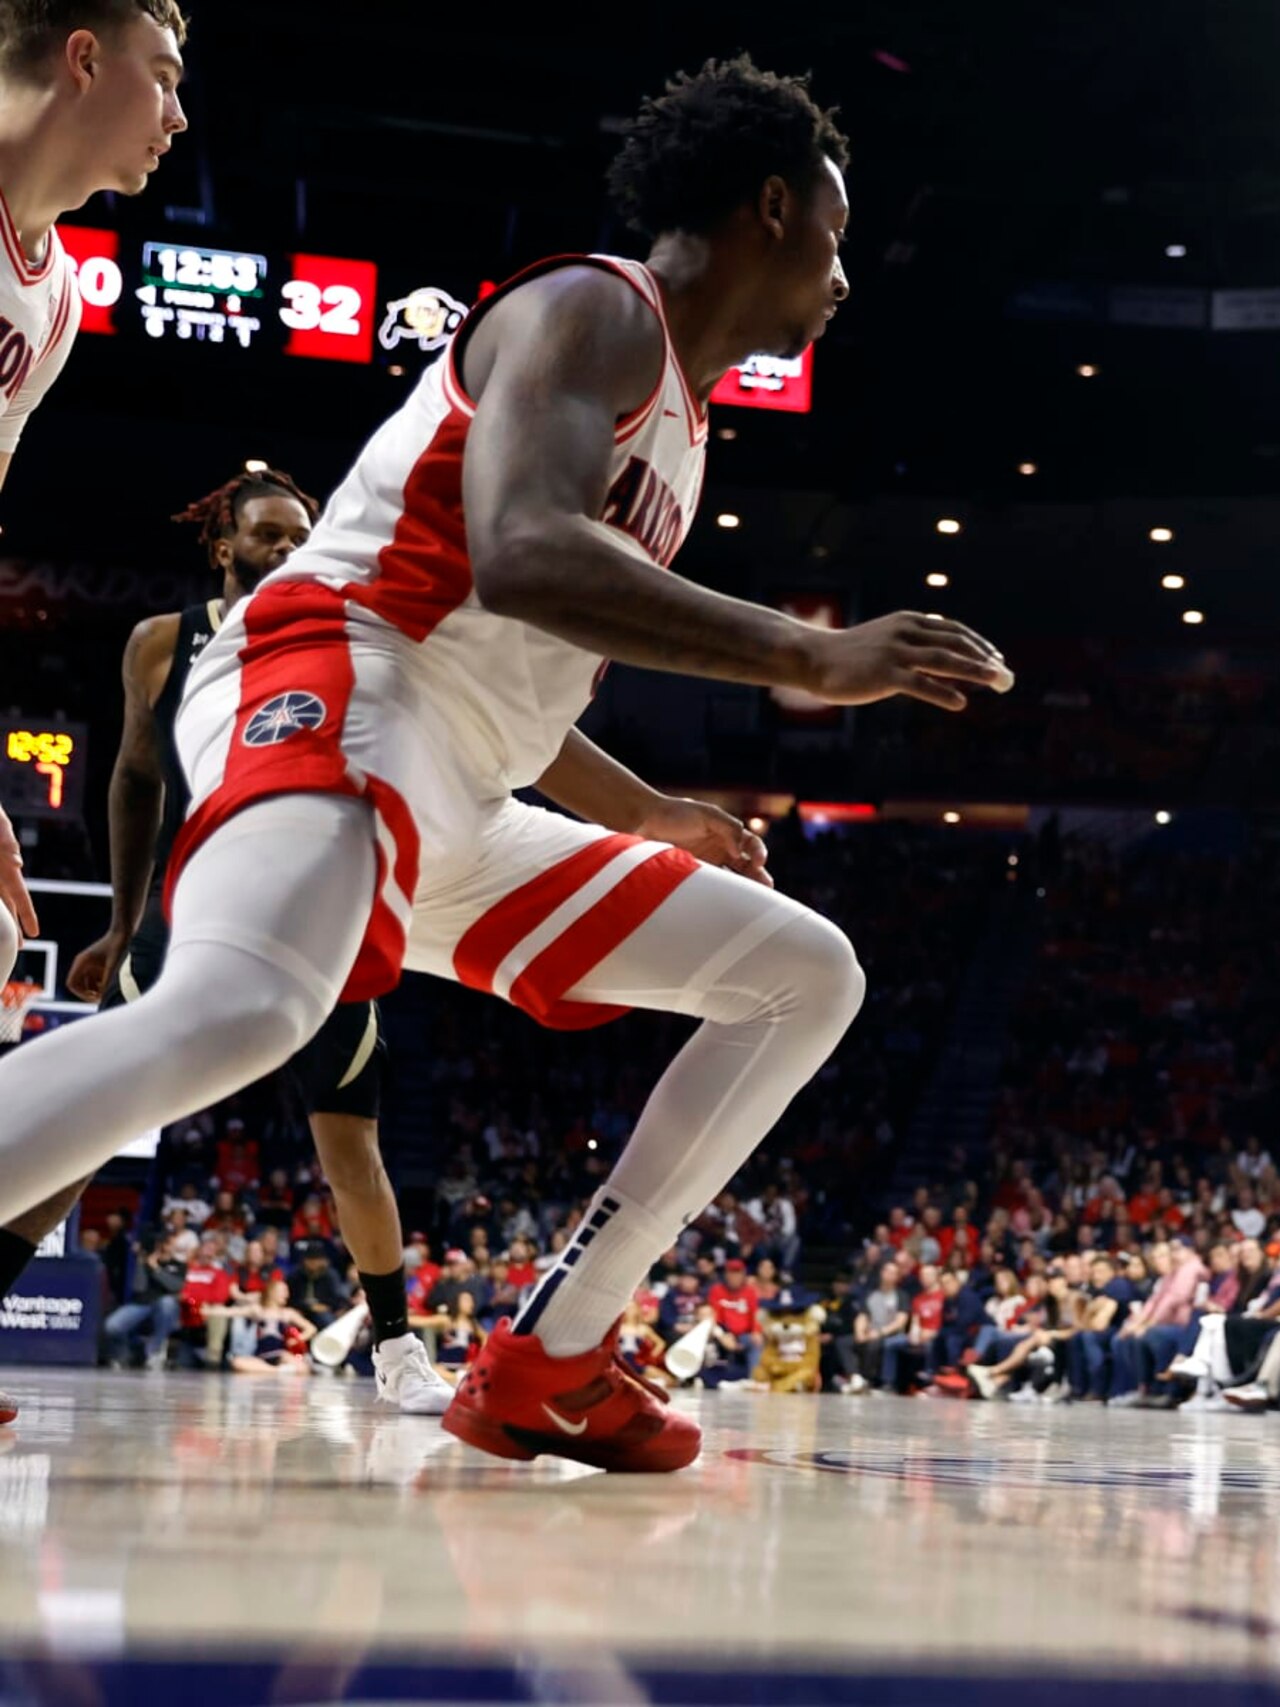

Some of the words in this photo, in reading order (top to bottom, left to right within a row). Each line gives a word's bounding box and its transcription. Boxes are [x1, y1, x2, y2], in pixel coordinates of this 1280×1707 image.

[64, 254, 123, 307] 0
[279, 280, 362, 336] 32
[35, 762, 63, 809] 7
[0, 1311, 47, 1330] West
[3, 1294, 83, 1316] Vantage
